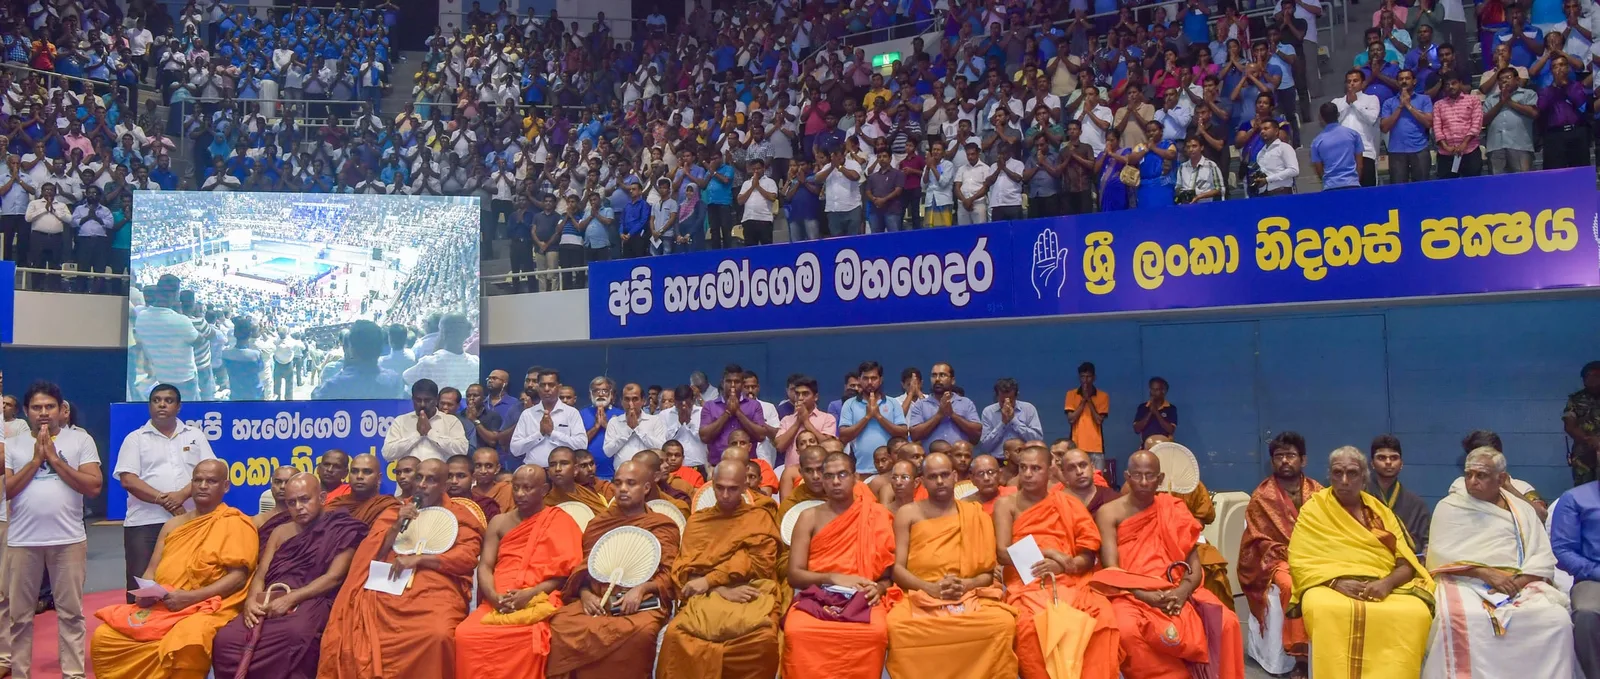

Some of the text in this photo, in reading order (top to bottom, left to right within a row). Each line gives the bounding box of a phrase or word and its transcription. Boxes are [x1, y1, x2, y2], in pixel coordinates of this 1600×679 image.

[608, 237, 993, 326] අපි හැමෝගෙම මහගෙදර
[1082, 231, 1116, 295] ශ්‍රී
[1132, 234, 1240, 290] ලංකා
[1255, 208, 1402, 281] නිදහස්
[231, 410, 351, 441] හැමෝගෙම
